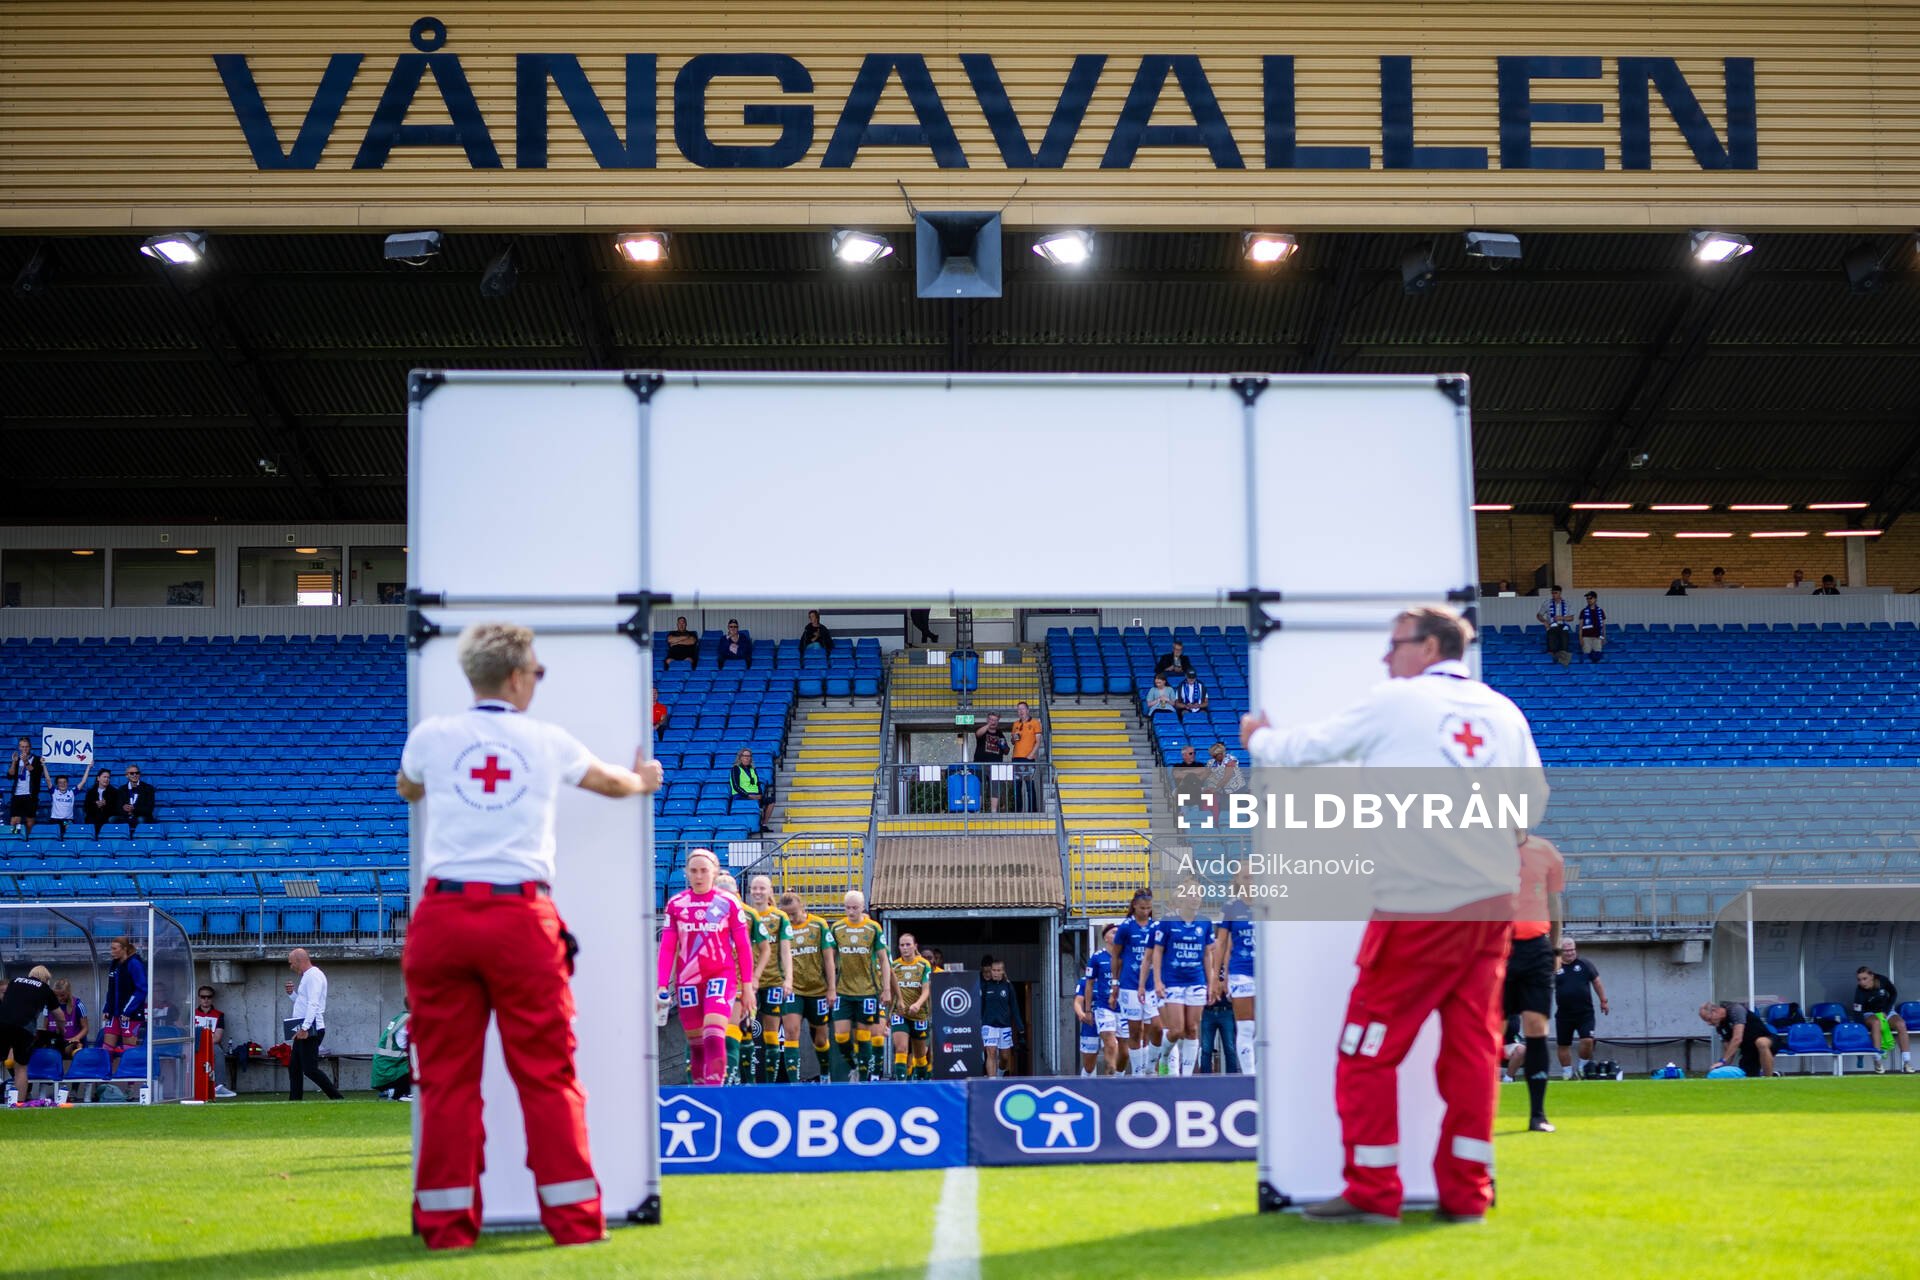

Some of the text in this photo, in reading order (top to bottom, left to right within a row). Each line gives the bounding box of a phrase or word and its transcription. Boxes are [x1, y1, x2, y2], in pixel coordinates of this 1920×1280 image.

[212, 16, 1758, 170] VÅNGAVALLEN
[43, 734, 93, 757] SNOKA
[790, 945, 818, 956] OLMEN
[736, 1107, 941, 1159] OBOS
[1115, 1099, 1258, 1150] OBO
